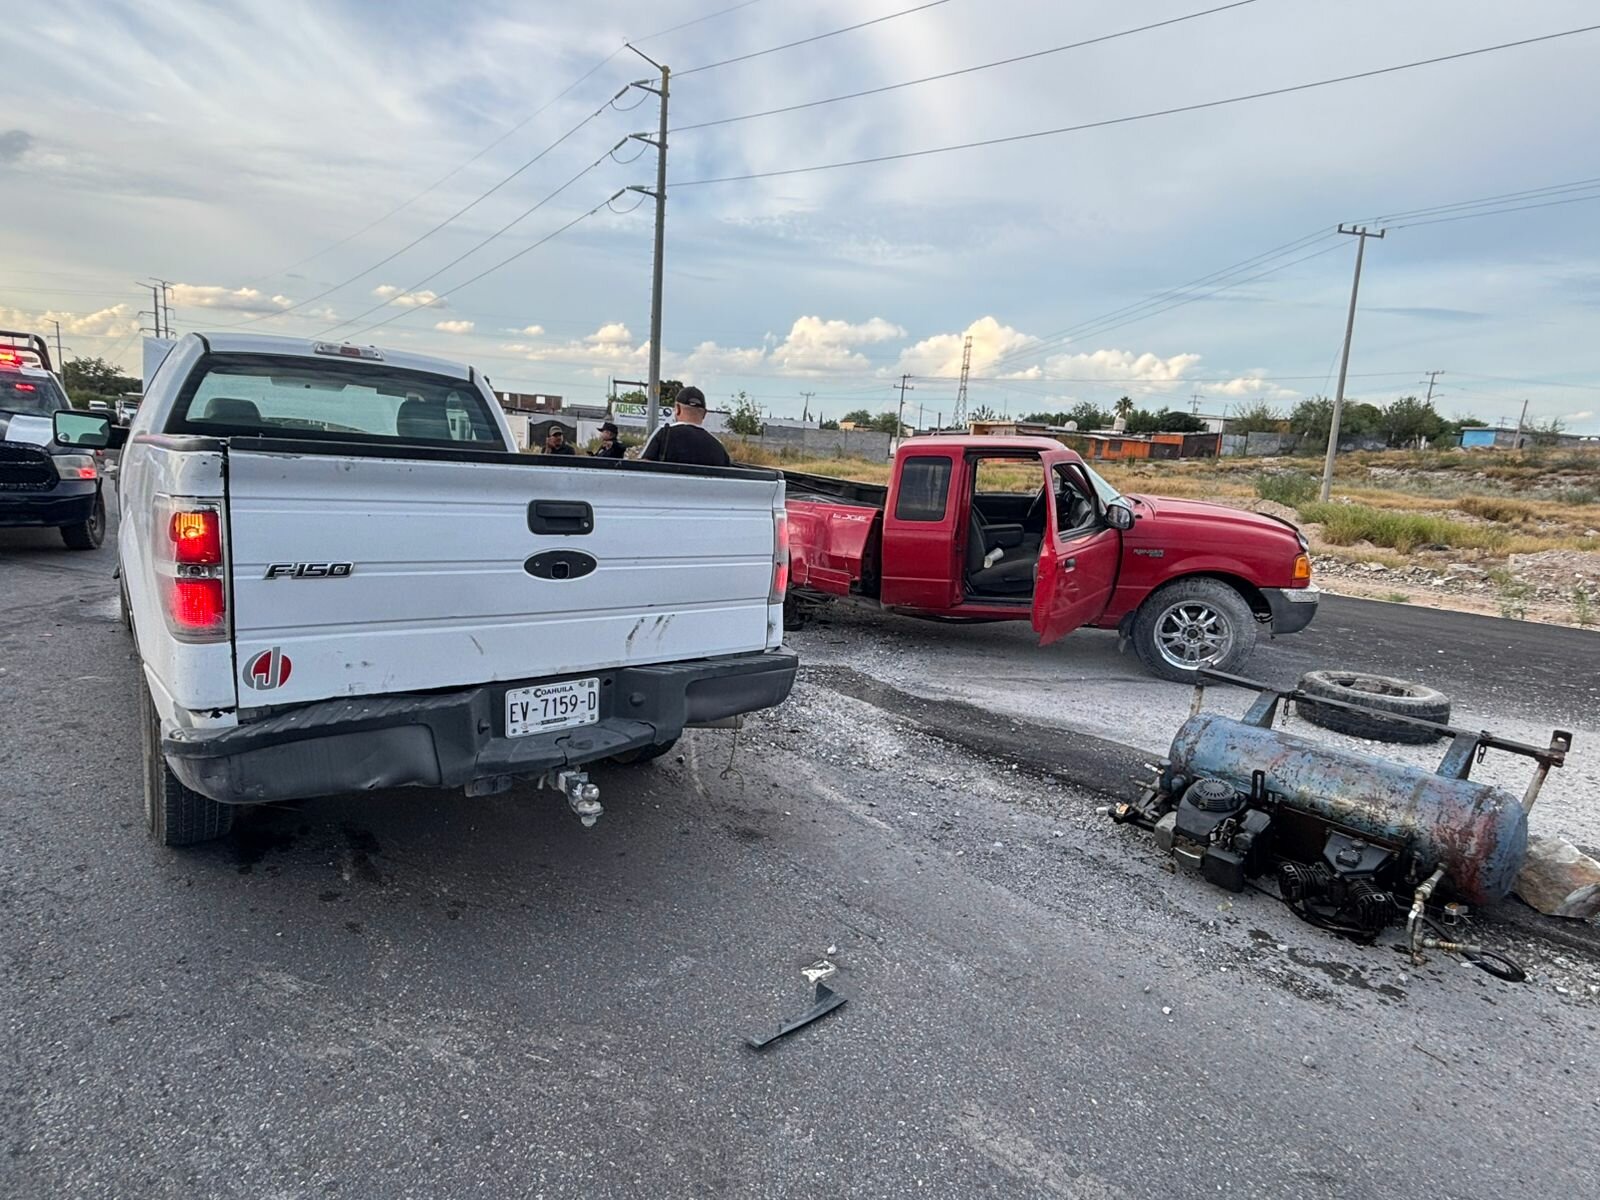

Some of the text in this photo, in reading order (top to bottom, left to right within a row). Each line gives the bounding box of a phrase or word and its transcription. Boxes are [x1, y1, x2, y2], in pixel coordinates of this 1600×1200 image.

[615, 403, 672, 417] ADHESSCO
[263, 562, 354, 580] F-150
[510, 691, 596, 724] EV-7159-D
